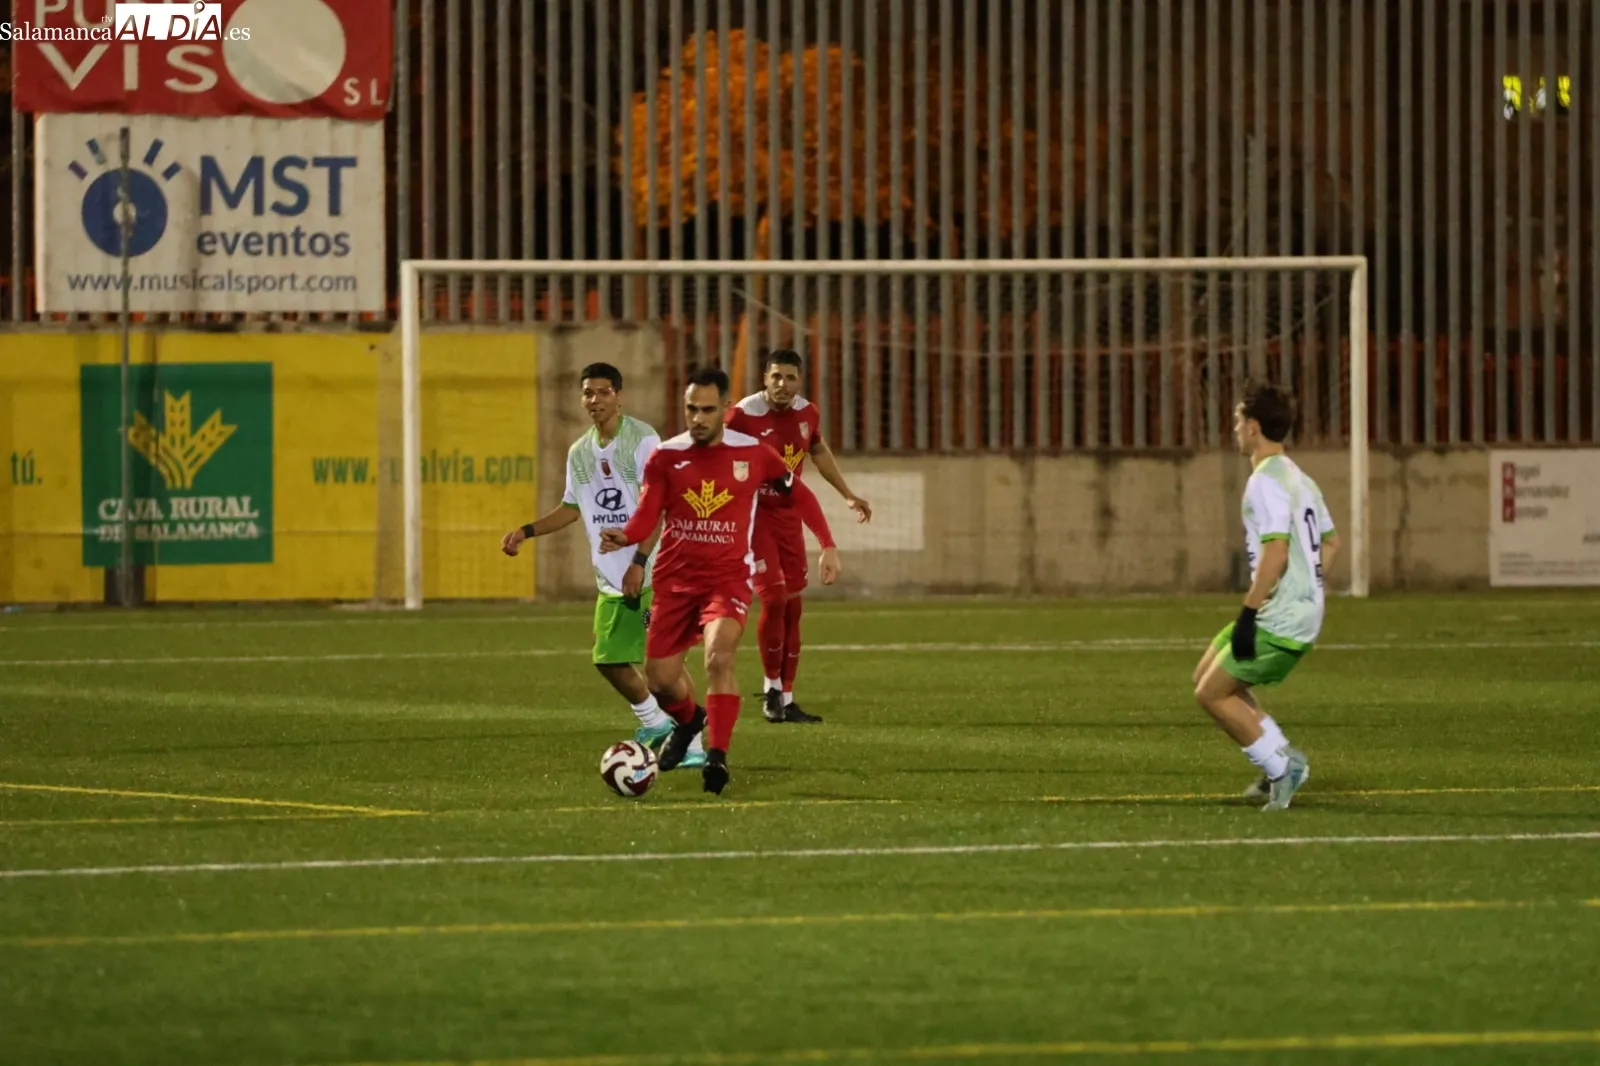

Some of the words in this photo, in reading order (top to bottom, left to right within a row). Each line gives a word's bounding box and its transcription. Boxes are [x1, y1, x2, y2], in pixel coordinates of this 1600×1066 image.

[200, 155, 357, 217] MST
[197, 226, 351, 257] eventos
[67, 268, 357, 293] www.musicalsport.com
[10, 450, 42, 486] tú.
[170, 497, 259, 519] RURAL
[695, 520, 738, 533] RURAL
